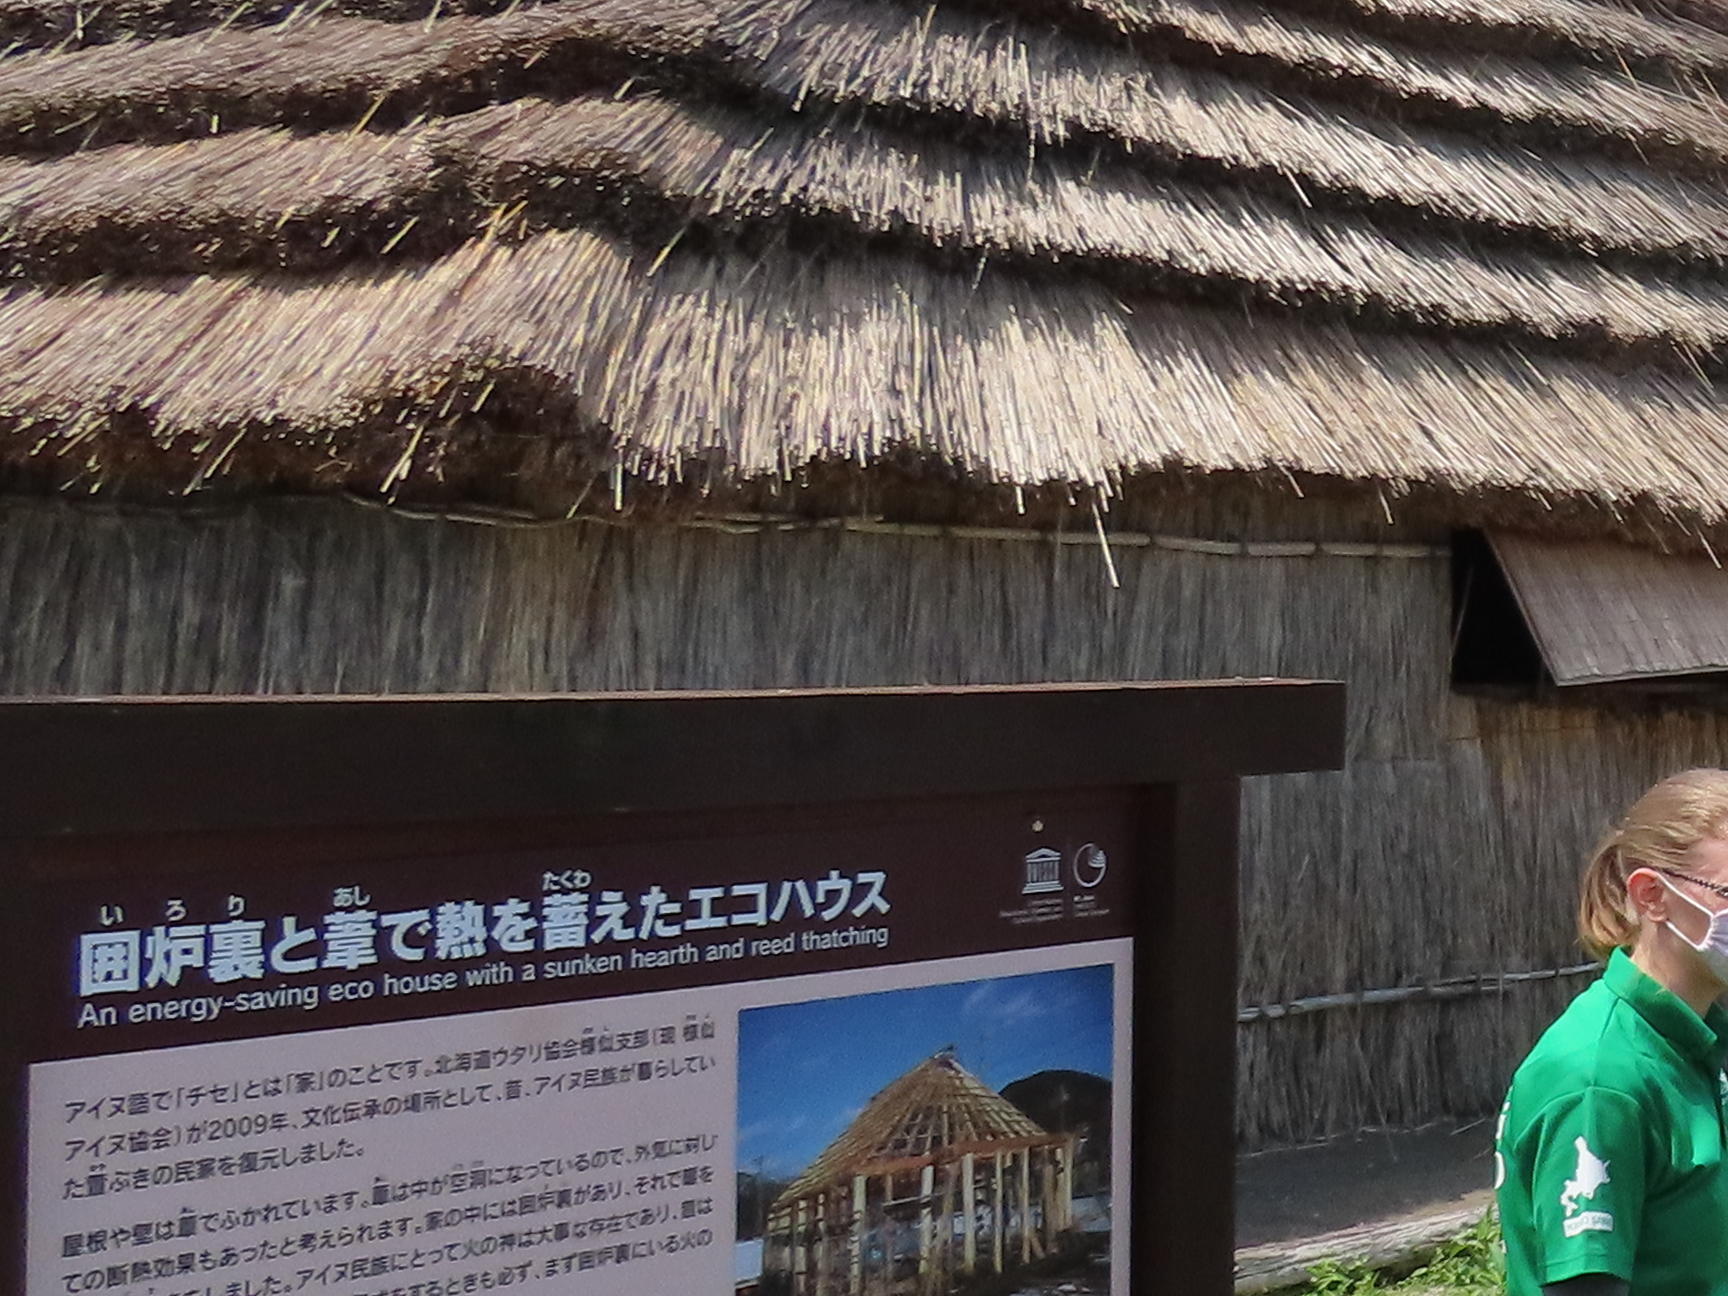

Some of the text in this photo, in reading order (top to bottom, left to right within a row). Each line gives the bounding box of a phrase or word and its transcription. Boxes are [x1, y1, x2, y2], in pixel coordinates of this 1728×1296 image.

[77, 924, 889, 1030] An energy-saving eco house with a sunken hearth and reed thatching
[79, 869, 891, 997] 囲炉裏と葦で熱を蓄えたエコハウス
